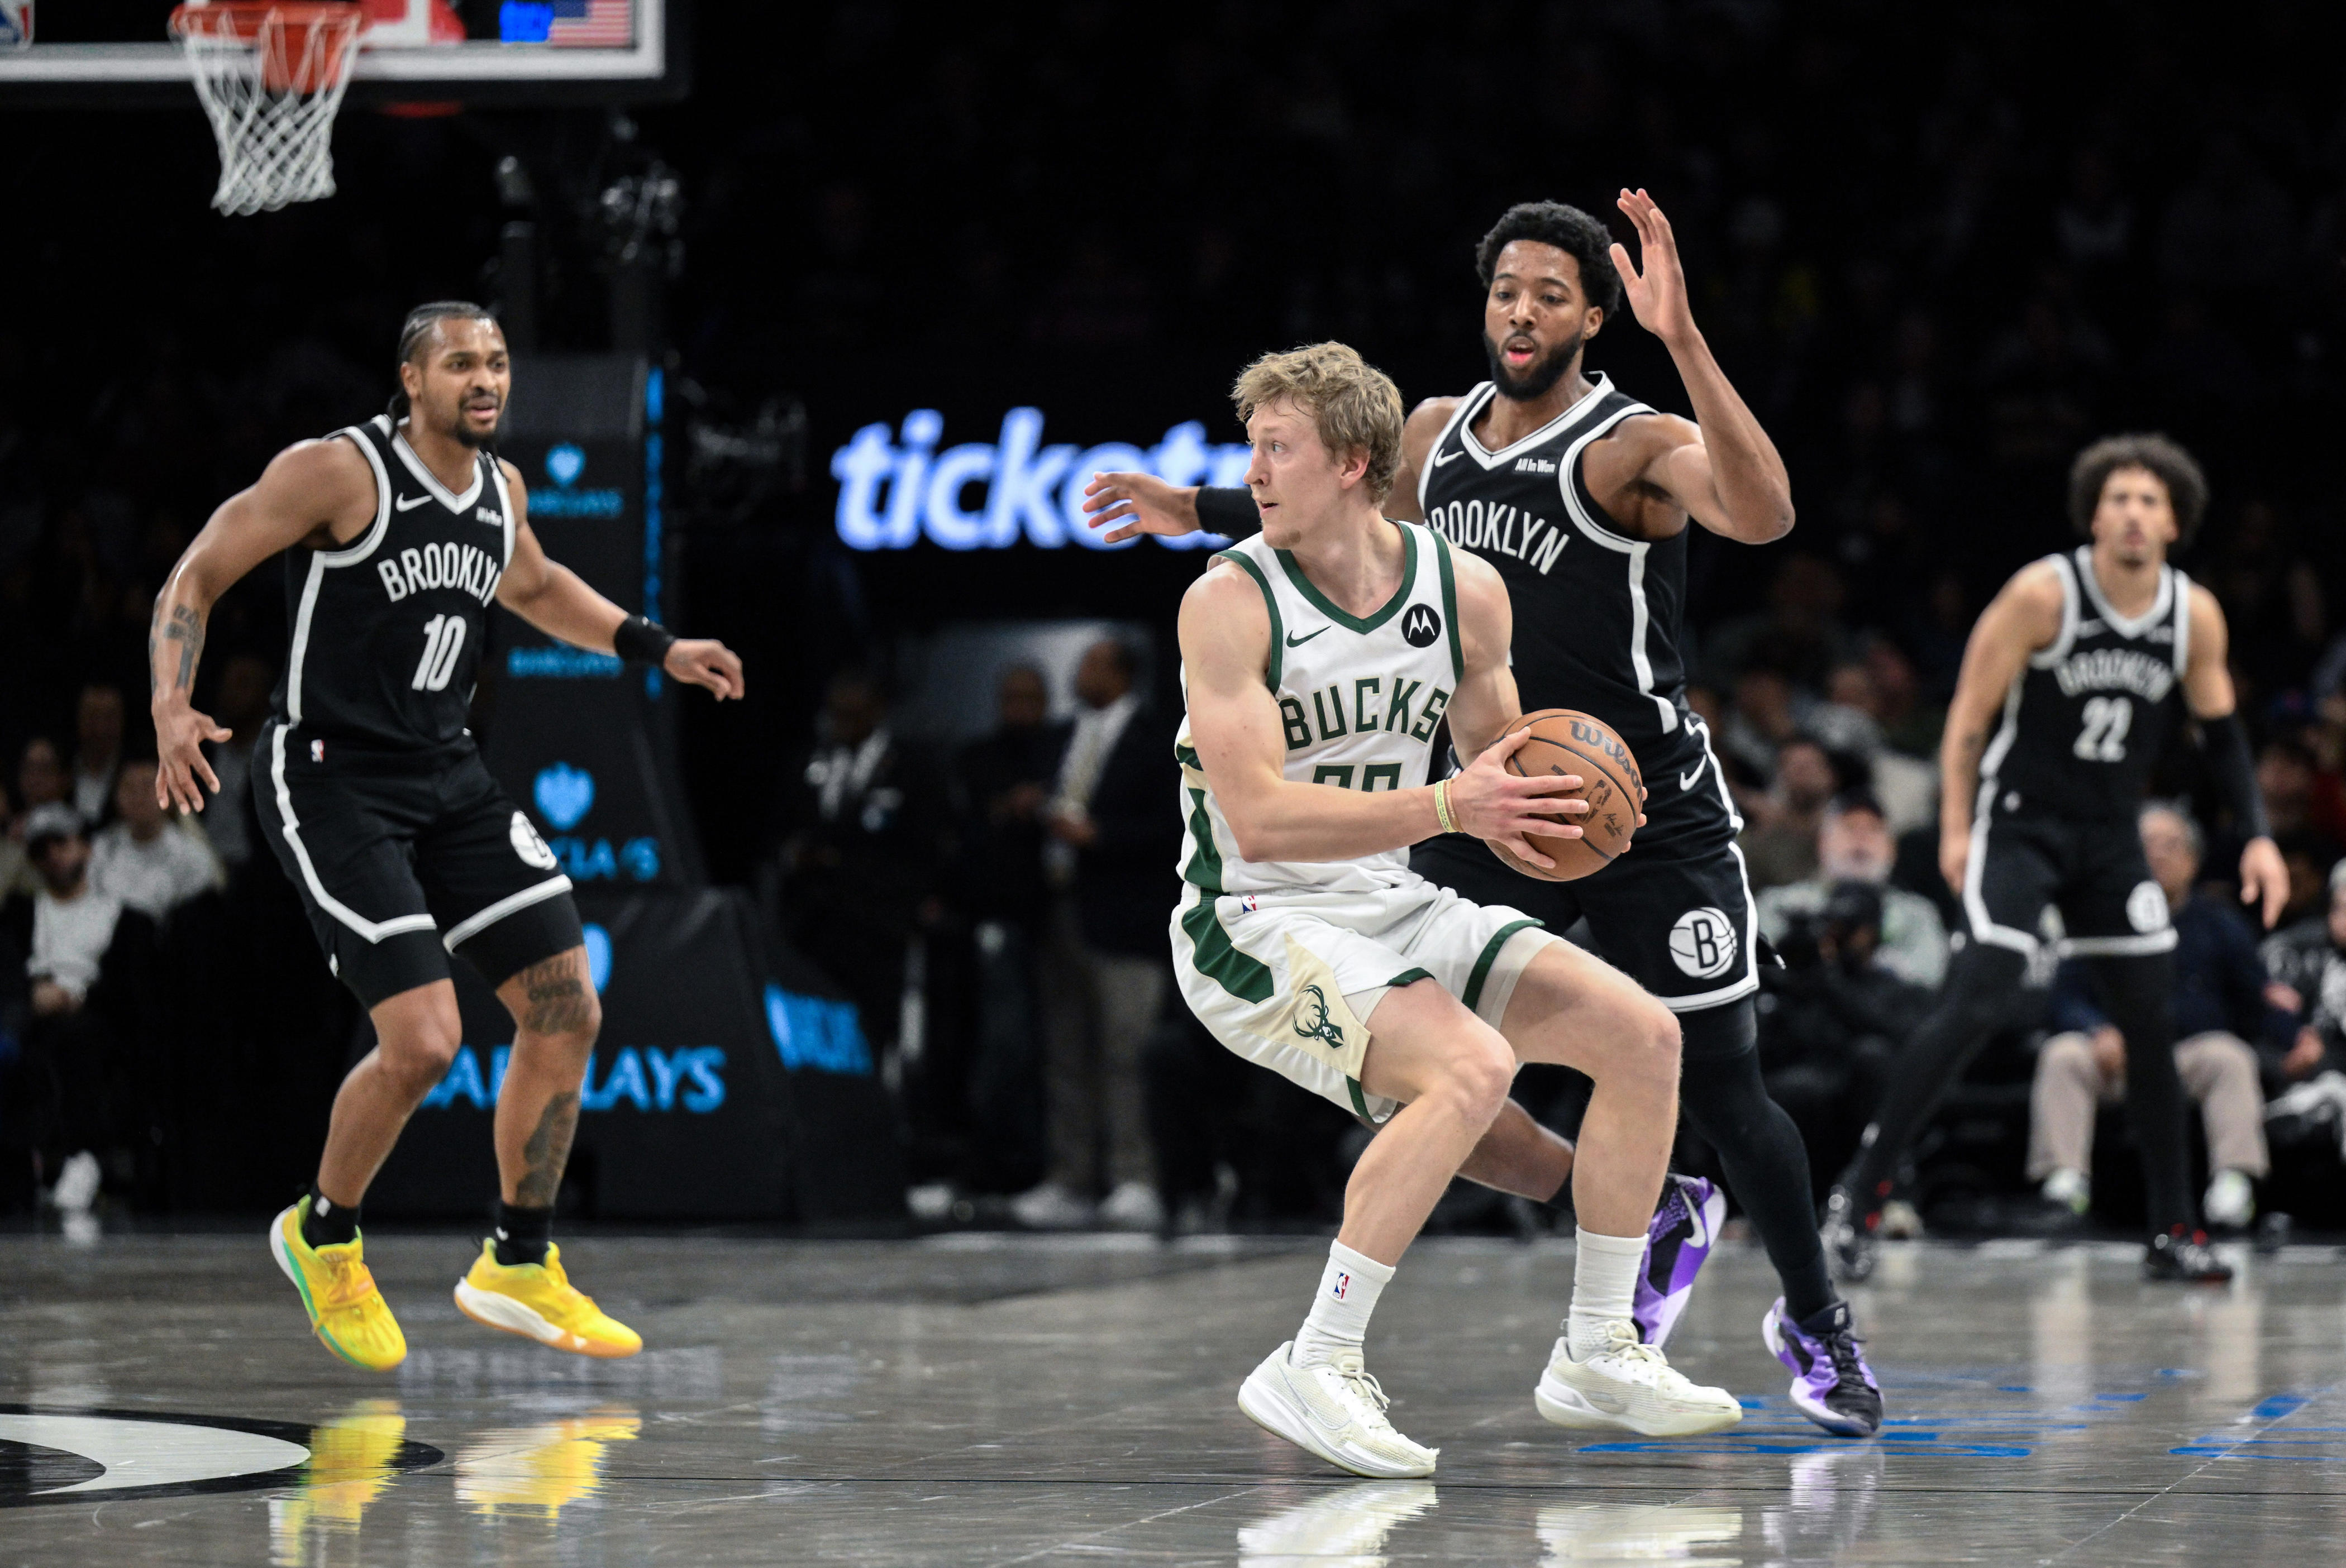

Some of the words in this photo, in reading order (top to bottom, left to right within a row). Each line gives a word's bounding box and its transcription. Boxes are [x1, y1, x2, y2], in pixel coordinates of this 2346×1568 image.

[831, 407, 1253, 550] ticket
[1424, 500, 1570, 575] ROOKLYN
[412, 614, 466, 692] 10
[1278, 676, 1451, 750] BUCKS
[2073, 696, 2133, 762] 22
[1692, 919, 1719, 968] B
